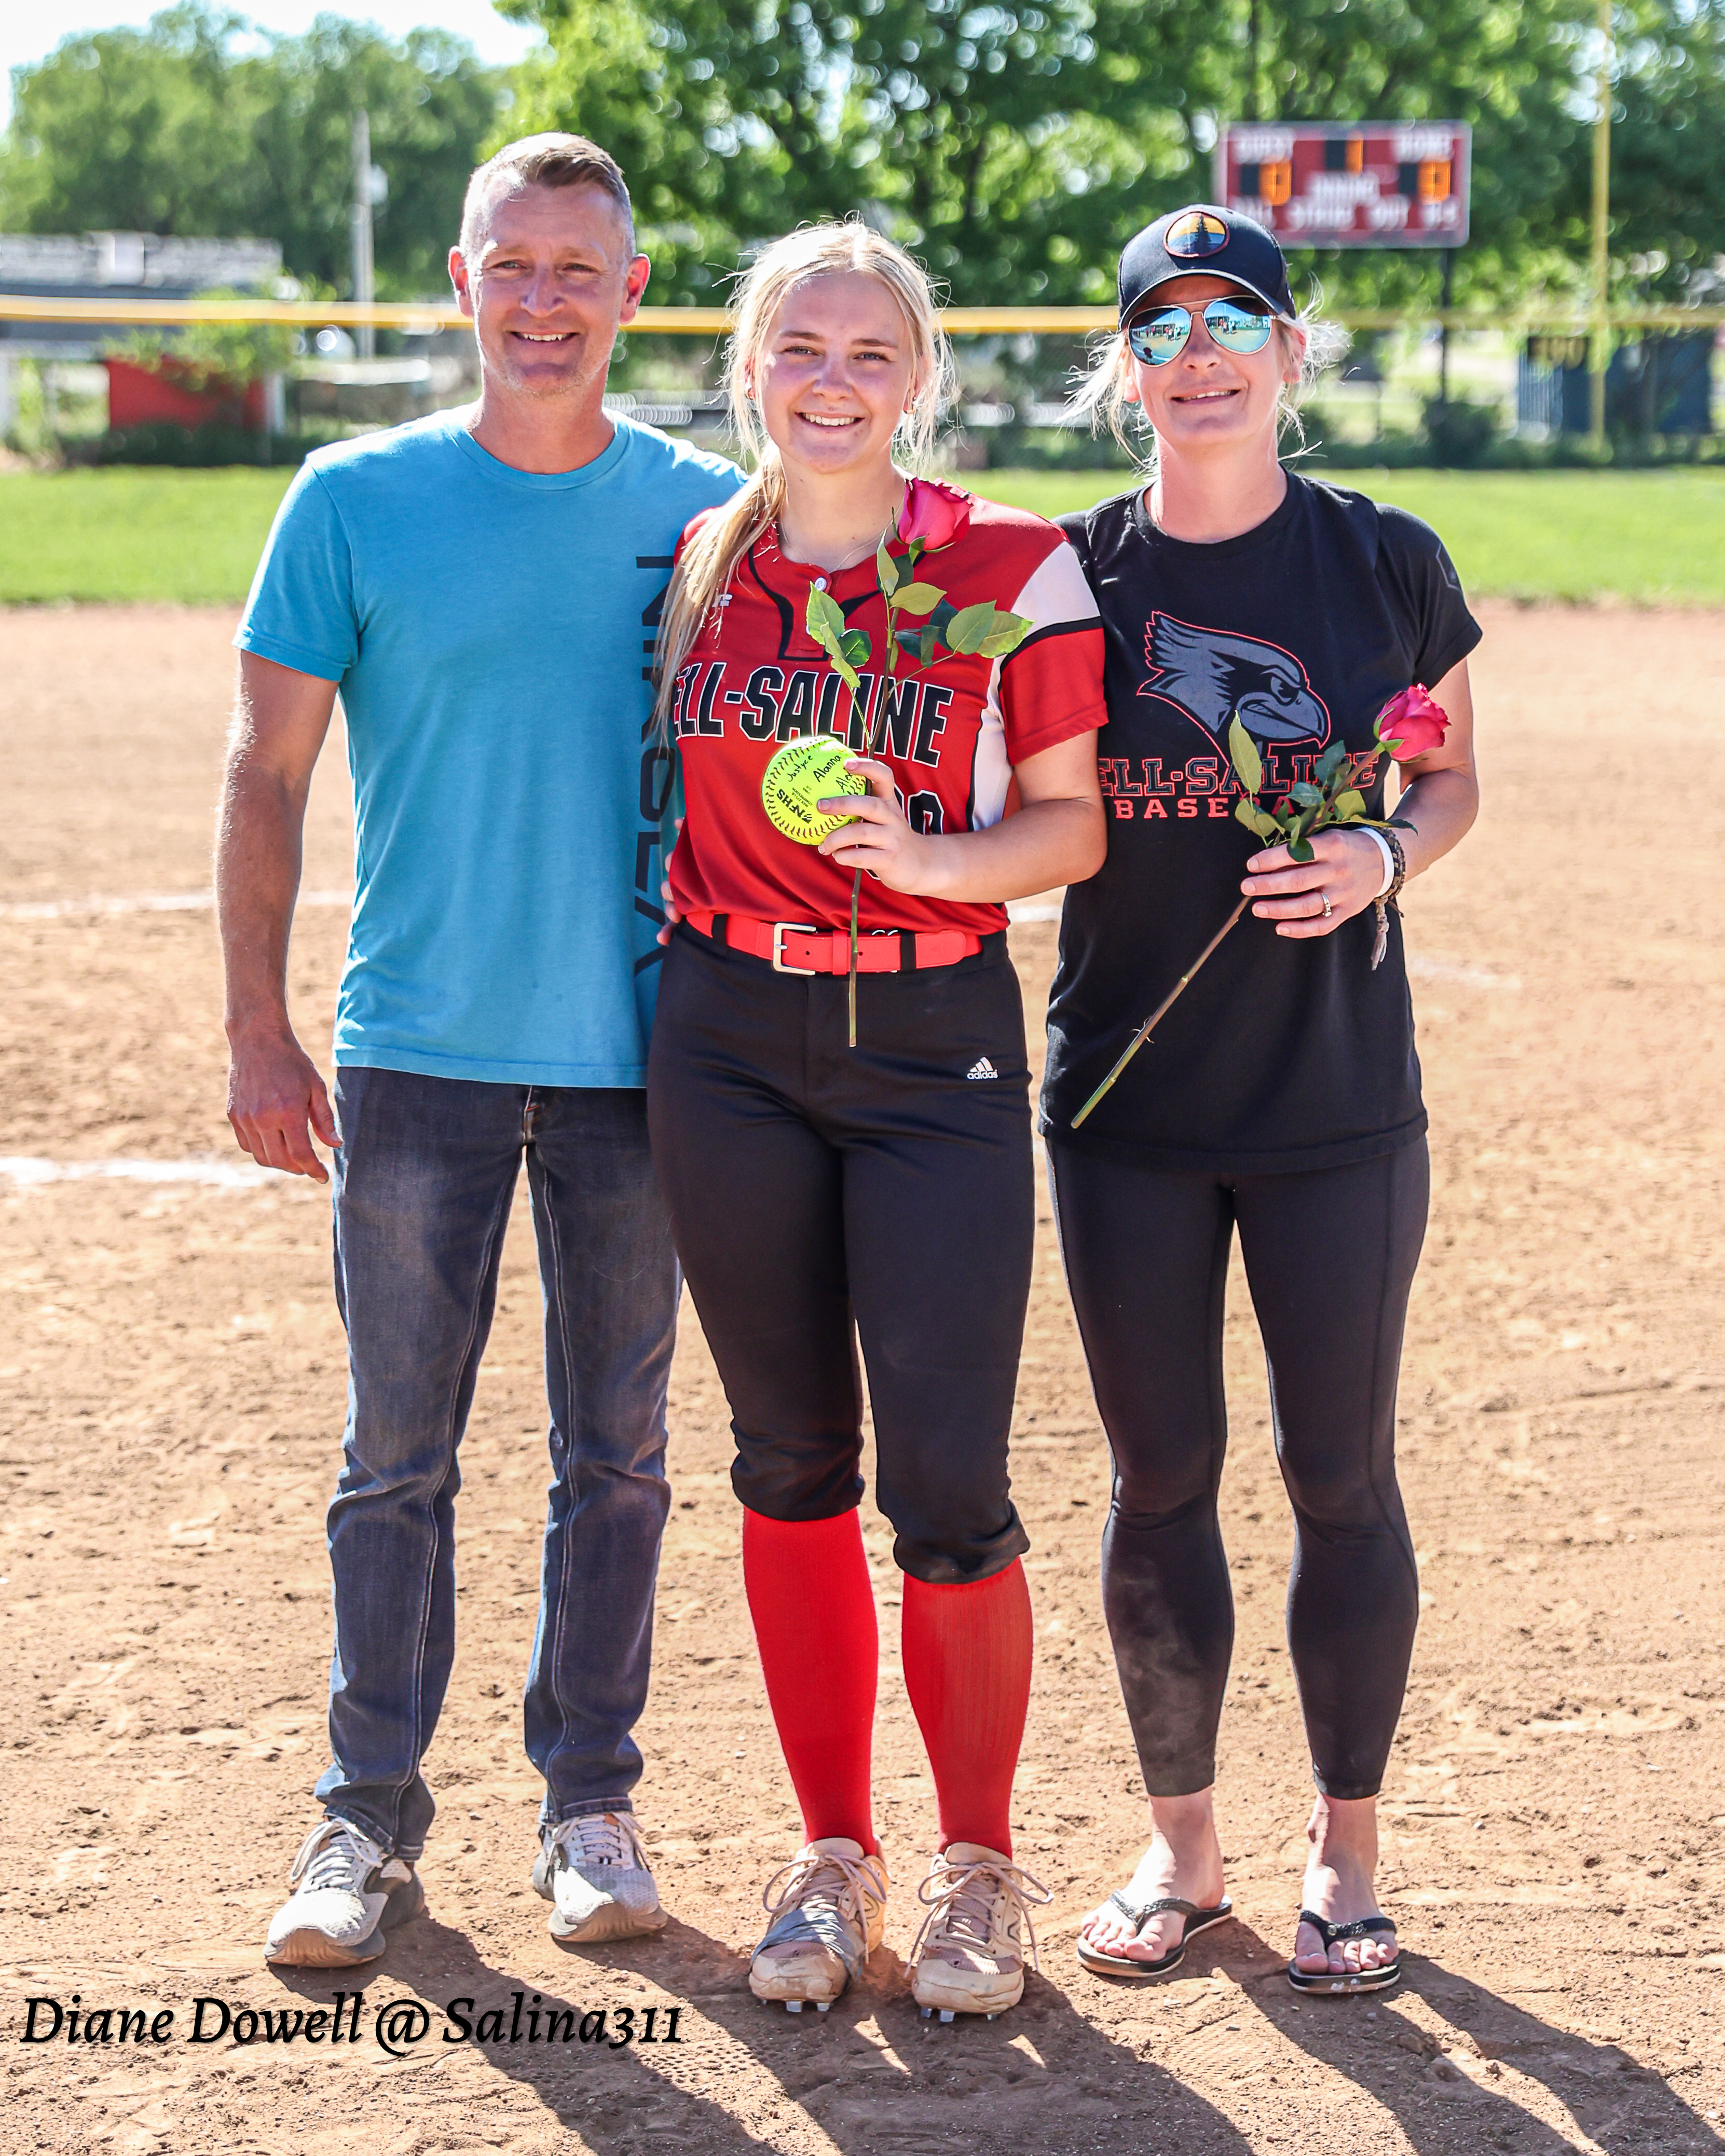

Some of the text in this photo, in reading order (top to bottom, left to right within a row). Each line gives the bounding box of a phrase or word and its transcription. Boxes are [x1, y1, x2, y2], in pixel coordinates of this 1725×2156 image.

[813, 754, 842, 782] Alanna
[776, 789, 805, 818] NFHS
[967, 1071, 998, 1079] adidas
